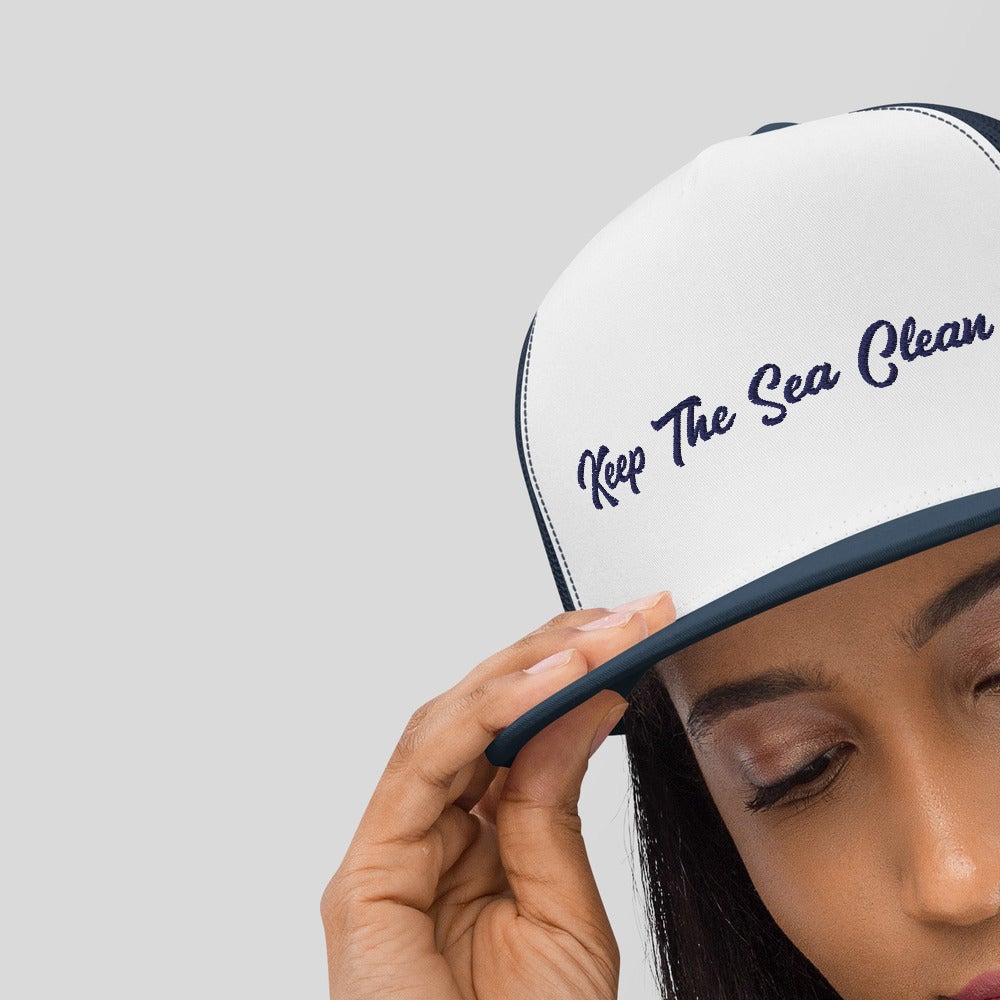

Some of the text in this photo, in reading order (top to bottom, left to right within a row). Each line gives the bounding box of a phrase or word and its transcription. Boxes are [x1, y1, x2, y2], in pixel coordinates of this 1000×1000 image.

[577, 313, 995, 510] Keep The Sea Clean
